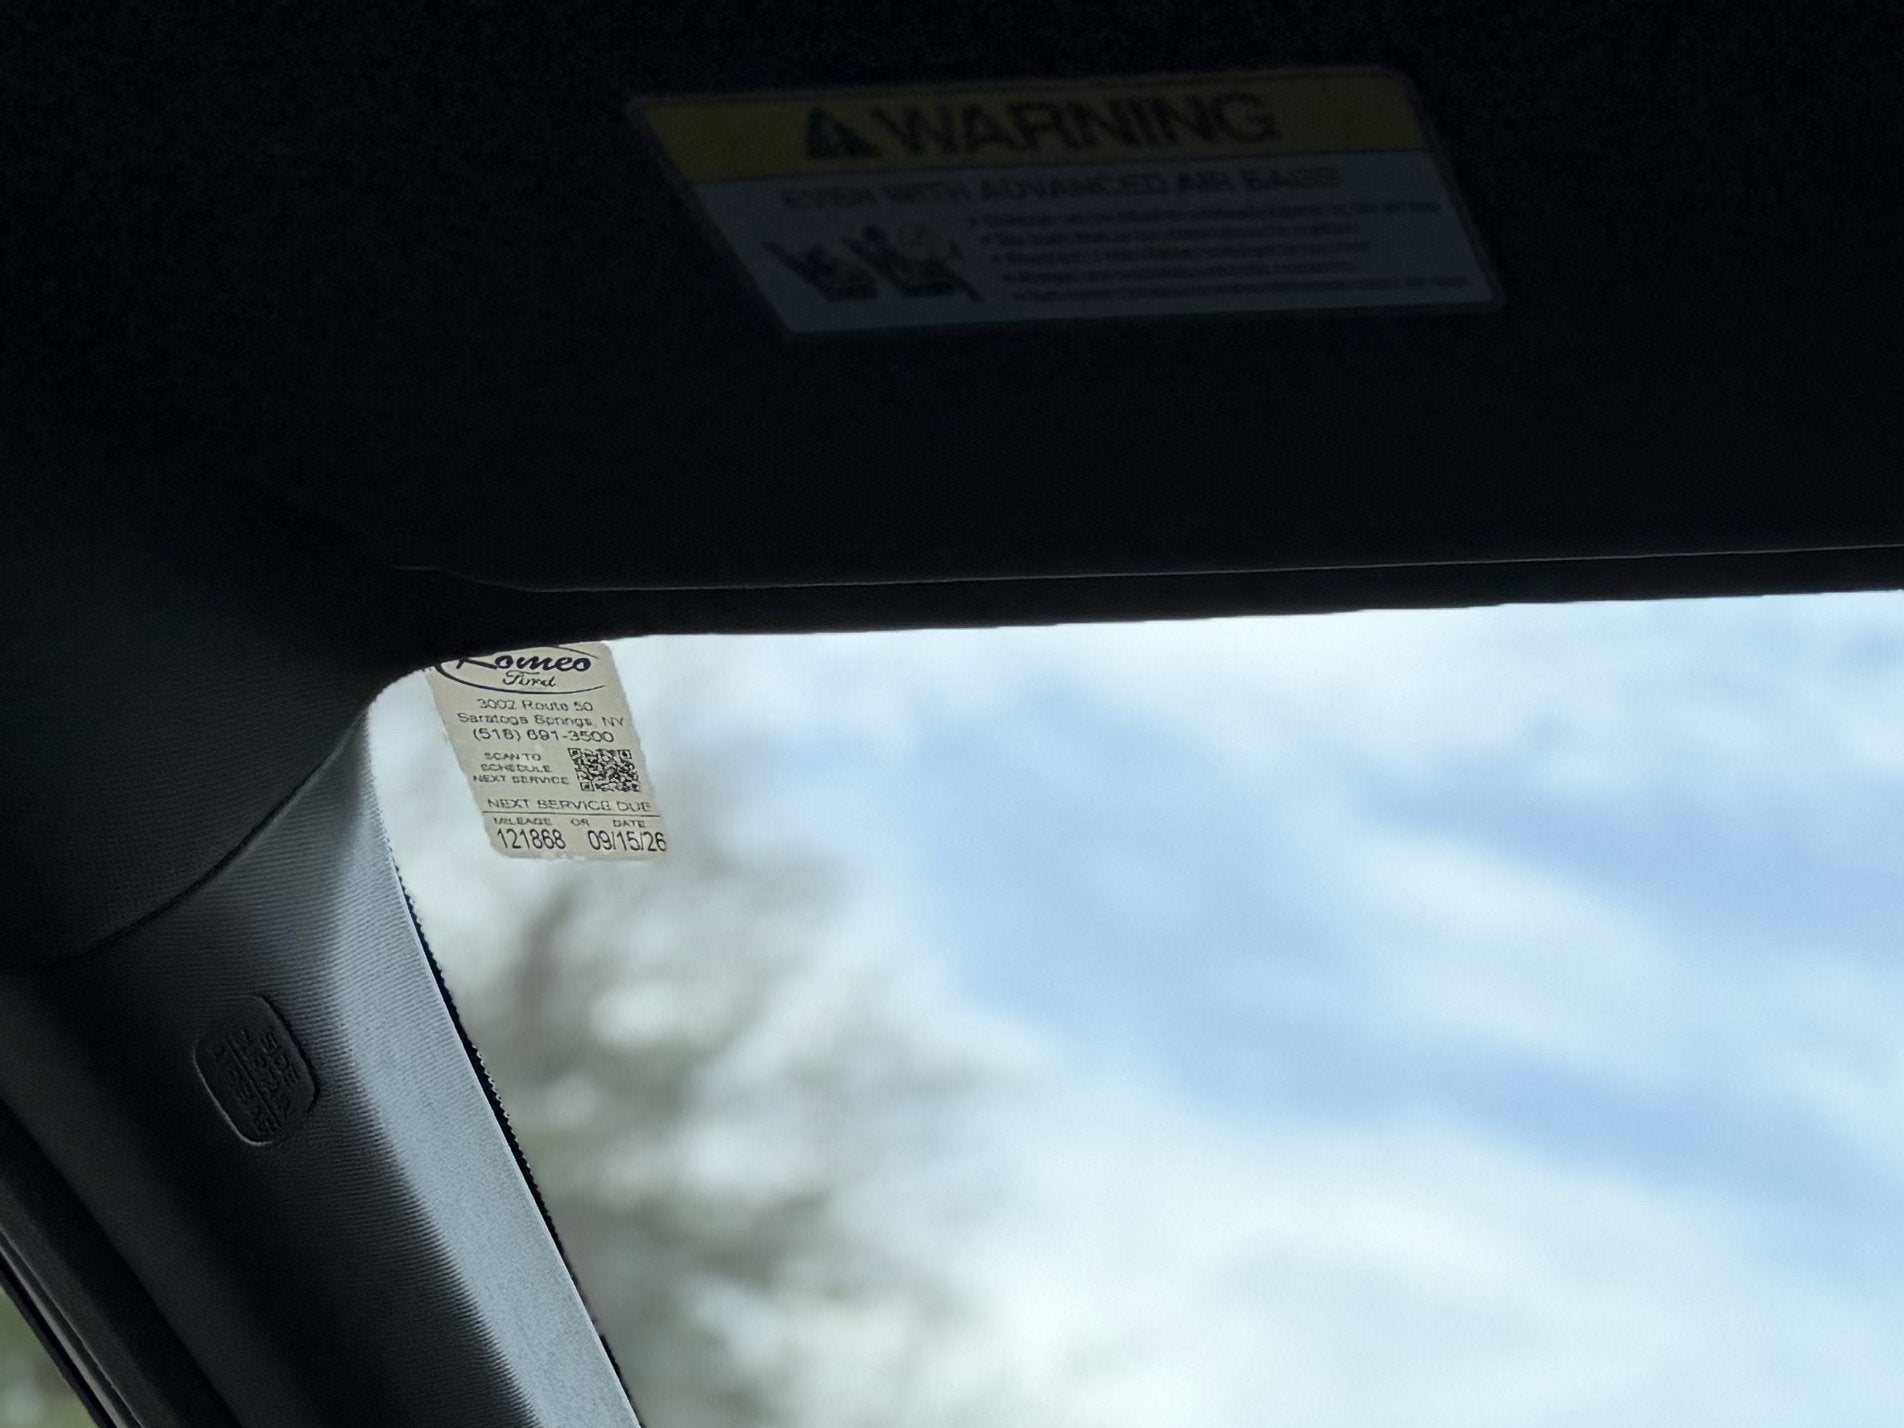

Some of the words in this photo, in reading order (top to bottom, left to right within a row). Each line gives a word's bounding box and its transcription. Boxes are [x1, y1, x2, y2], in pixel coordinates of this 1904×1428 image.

[871, 92, 1282, 153] WARNING
[979, 172, 1168, 201] ADVANCED
[1178, 170, 1233, 192] AIR
[502, 670, 556, 688] Ford
[602, 716, 624, 727] NY
[487, 798, 530, 810] NEXT
[538, 799, 611, 811] SERVICE
[617, 801, 653, 812] DUE
[612, 819, 646, 828] DATE
[497, 828, 566, 850] 121868
[588, 830, 667, 853] 09/15/26
